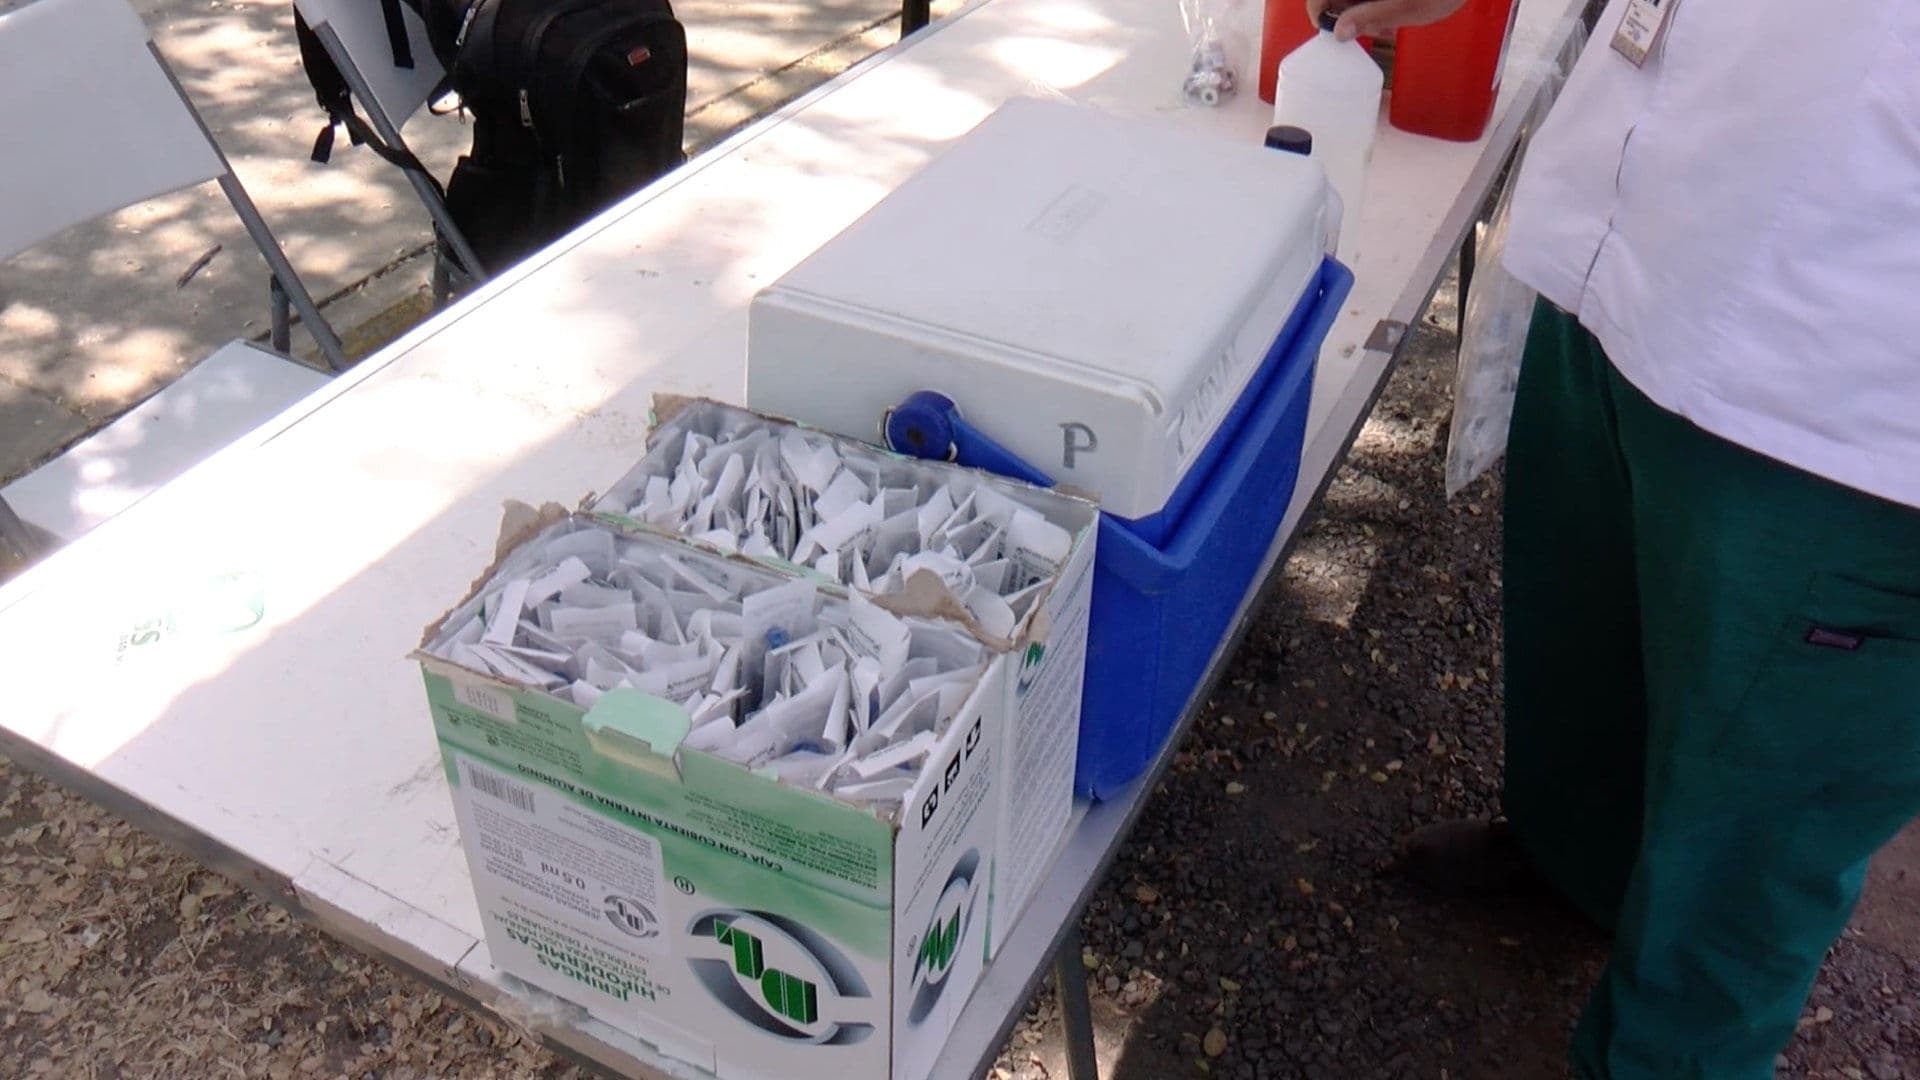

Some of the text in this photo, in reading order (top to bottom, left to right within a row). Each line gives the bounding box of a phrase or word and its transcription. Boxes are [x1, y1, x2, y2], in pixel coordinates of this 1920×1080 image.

[1057, 422, 1097, 469] P
[518, 764, 575, 791] ALUMINIO
[579, 787, 594, 800] DE
[596, 795, 652, 822] INTERNA
[655, 818, 716, 847] CUBIERTA
[719, 842, 748, 858] CON
[751, 853, 783, 872] CAJA
[536, 953, 629, 1001] JERINGAS
